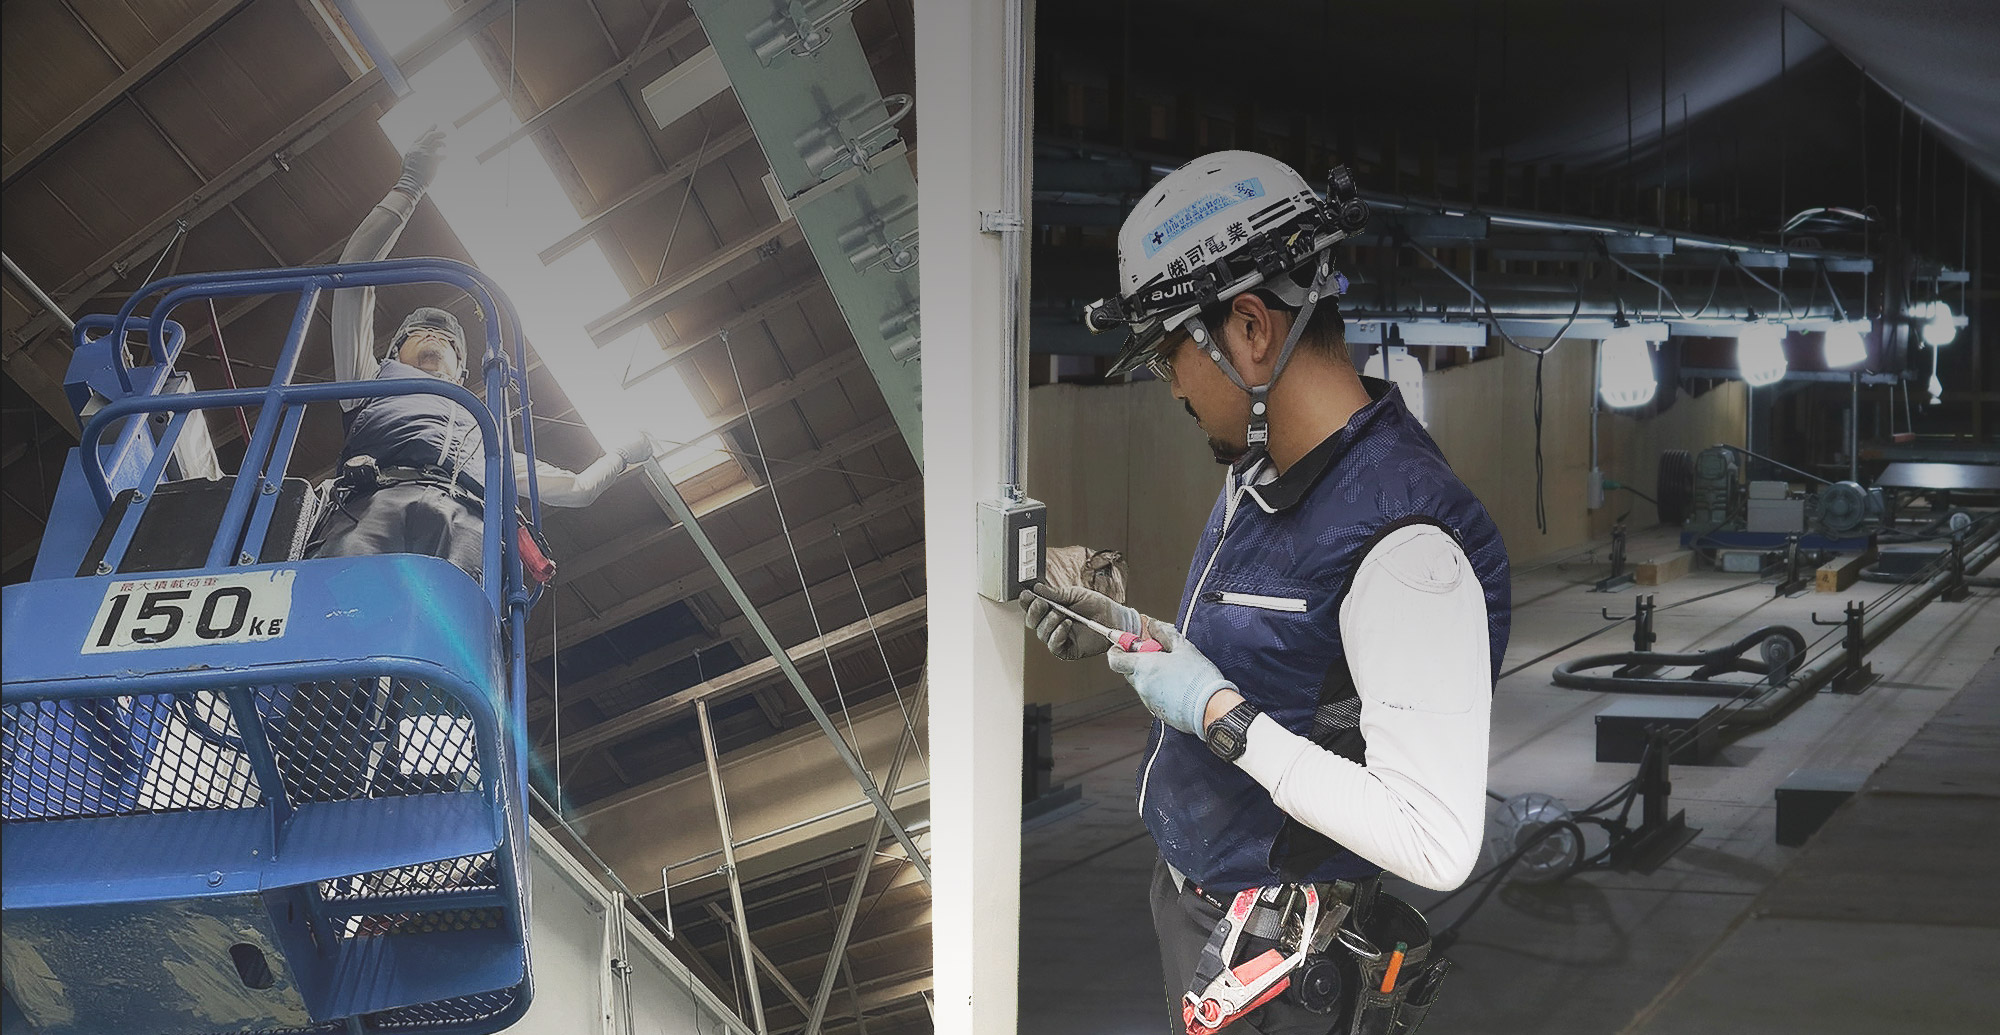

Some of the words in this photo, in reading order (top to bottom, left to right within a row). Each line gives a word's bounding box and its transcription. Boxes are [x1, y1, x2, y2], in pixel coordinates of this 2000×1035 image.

[1234, 182, 1256, 198] 安全
[120, 577, 219, 592] 最大積載荷重
